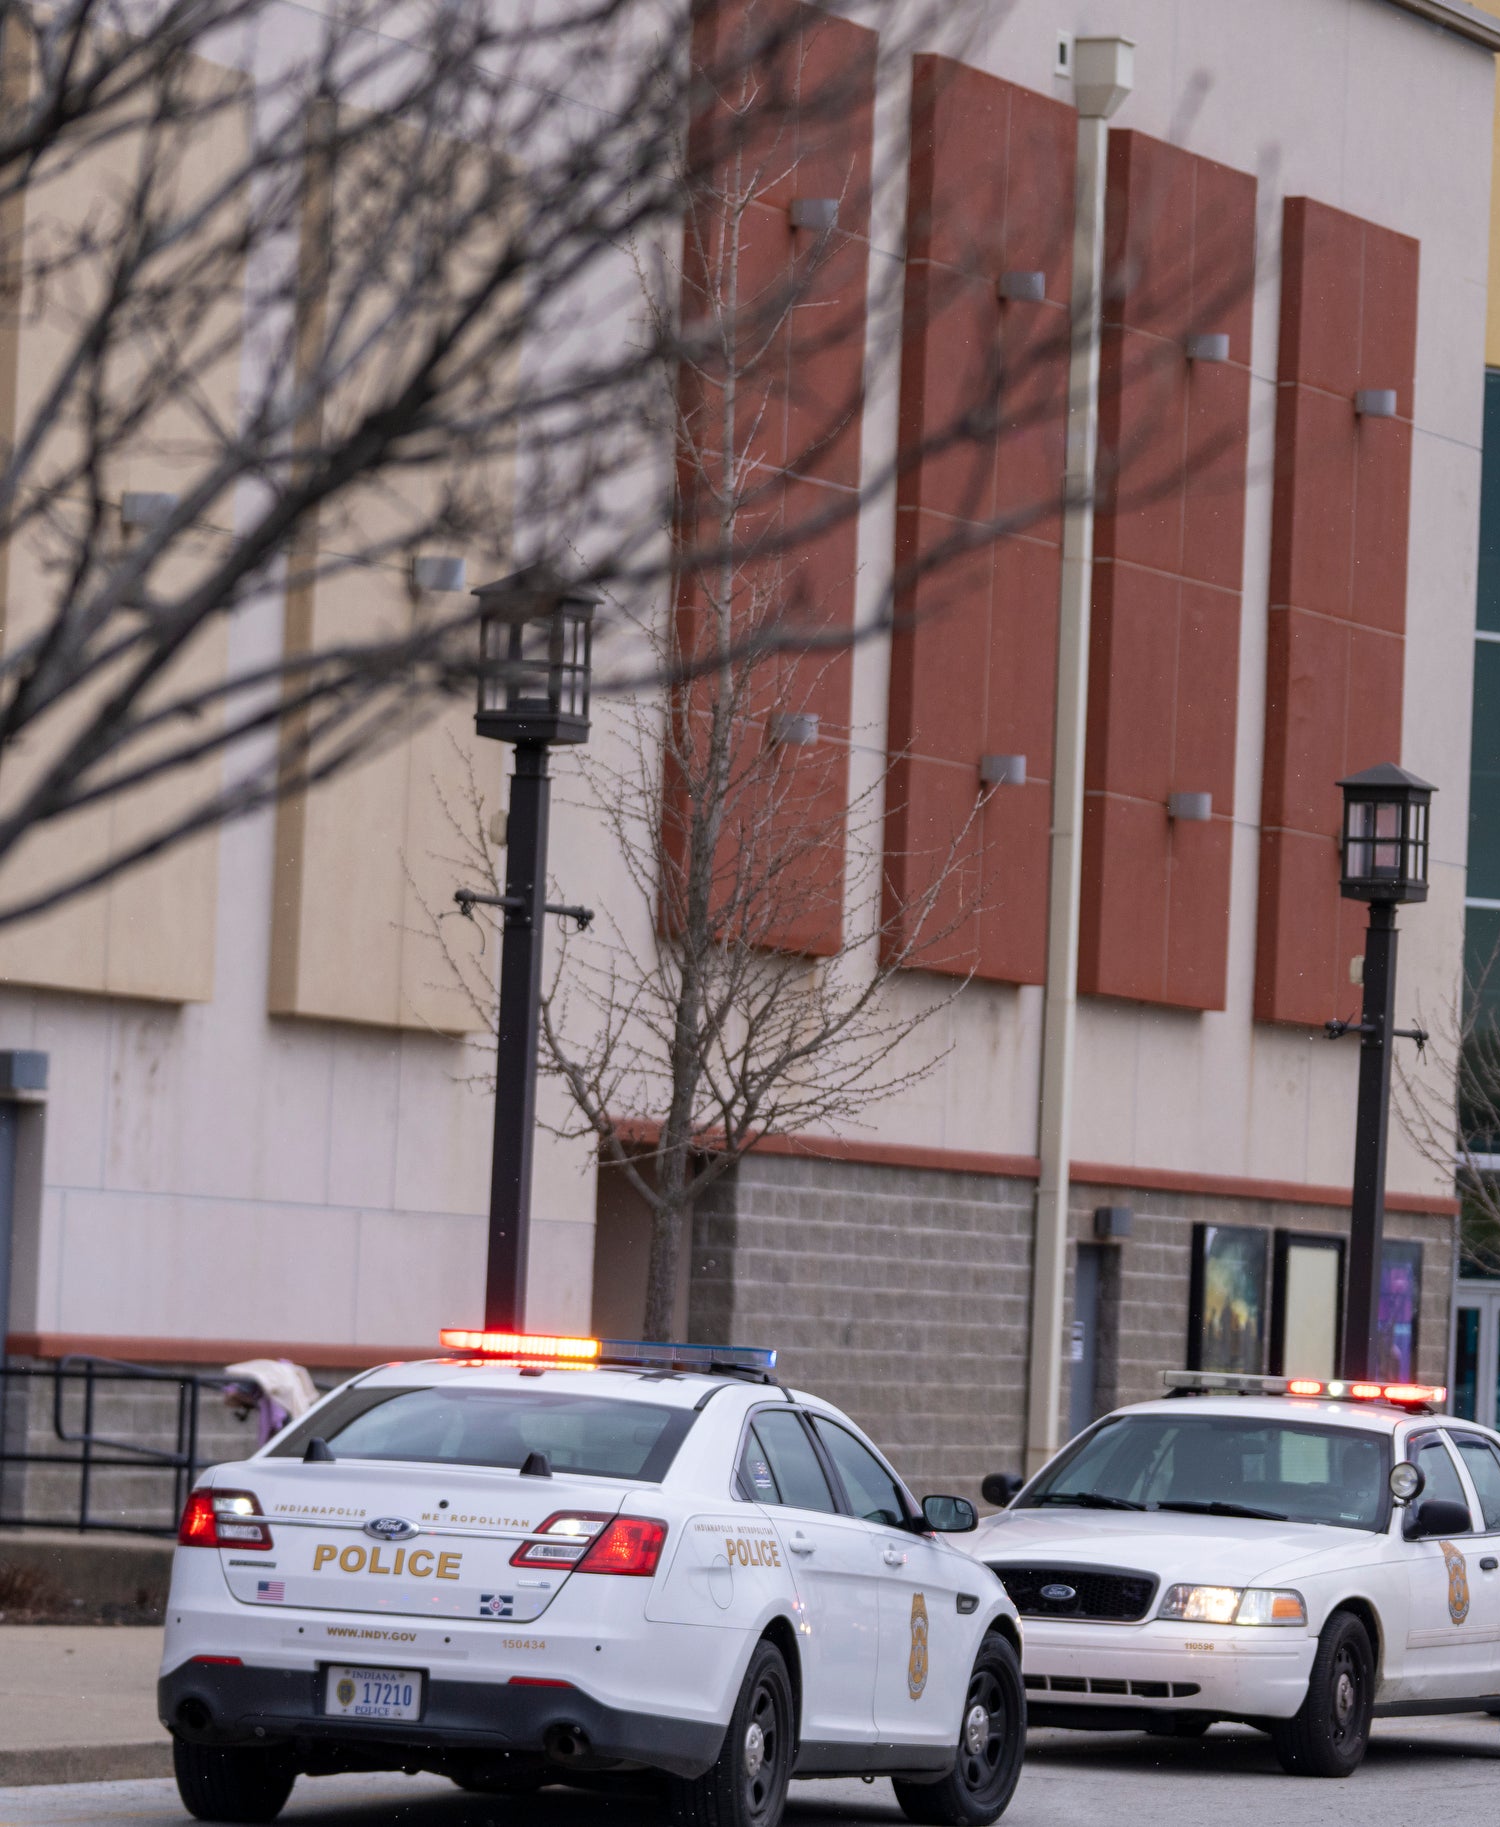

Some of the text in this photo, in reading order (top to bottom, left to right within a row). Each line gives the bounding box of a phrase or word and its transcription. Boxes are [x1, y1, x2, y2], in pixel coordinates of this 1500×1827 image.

[274, 1503, 531, 1528] INDIANAPOLIS MEROPOLITAN
[313, 1544, 463, 1580] POLICE
[725, 1538, 782, 1568] POLICE
[327, 1626, 417, 1642] WWW.INDY.GOV
[502, 1639, 546, 1650] 150434
[352, 1670, 397, 1681] INDIANA
[363, 1682, 413, 1707] 17210
[354, 1705, 391, 1716] POLICE
